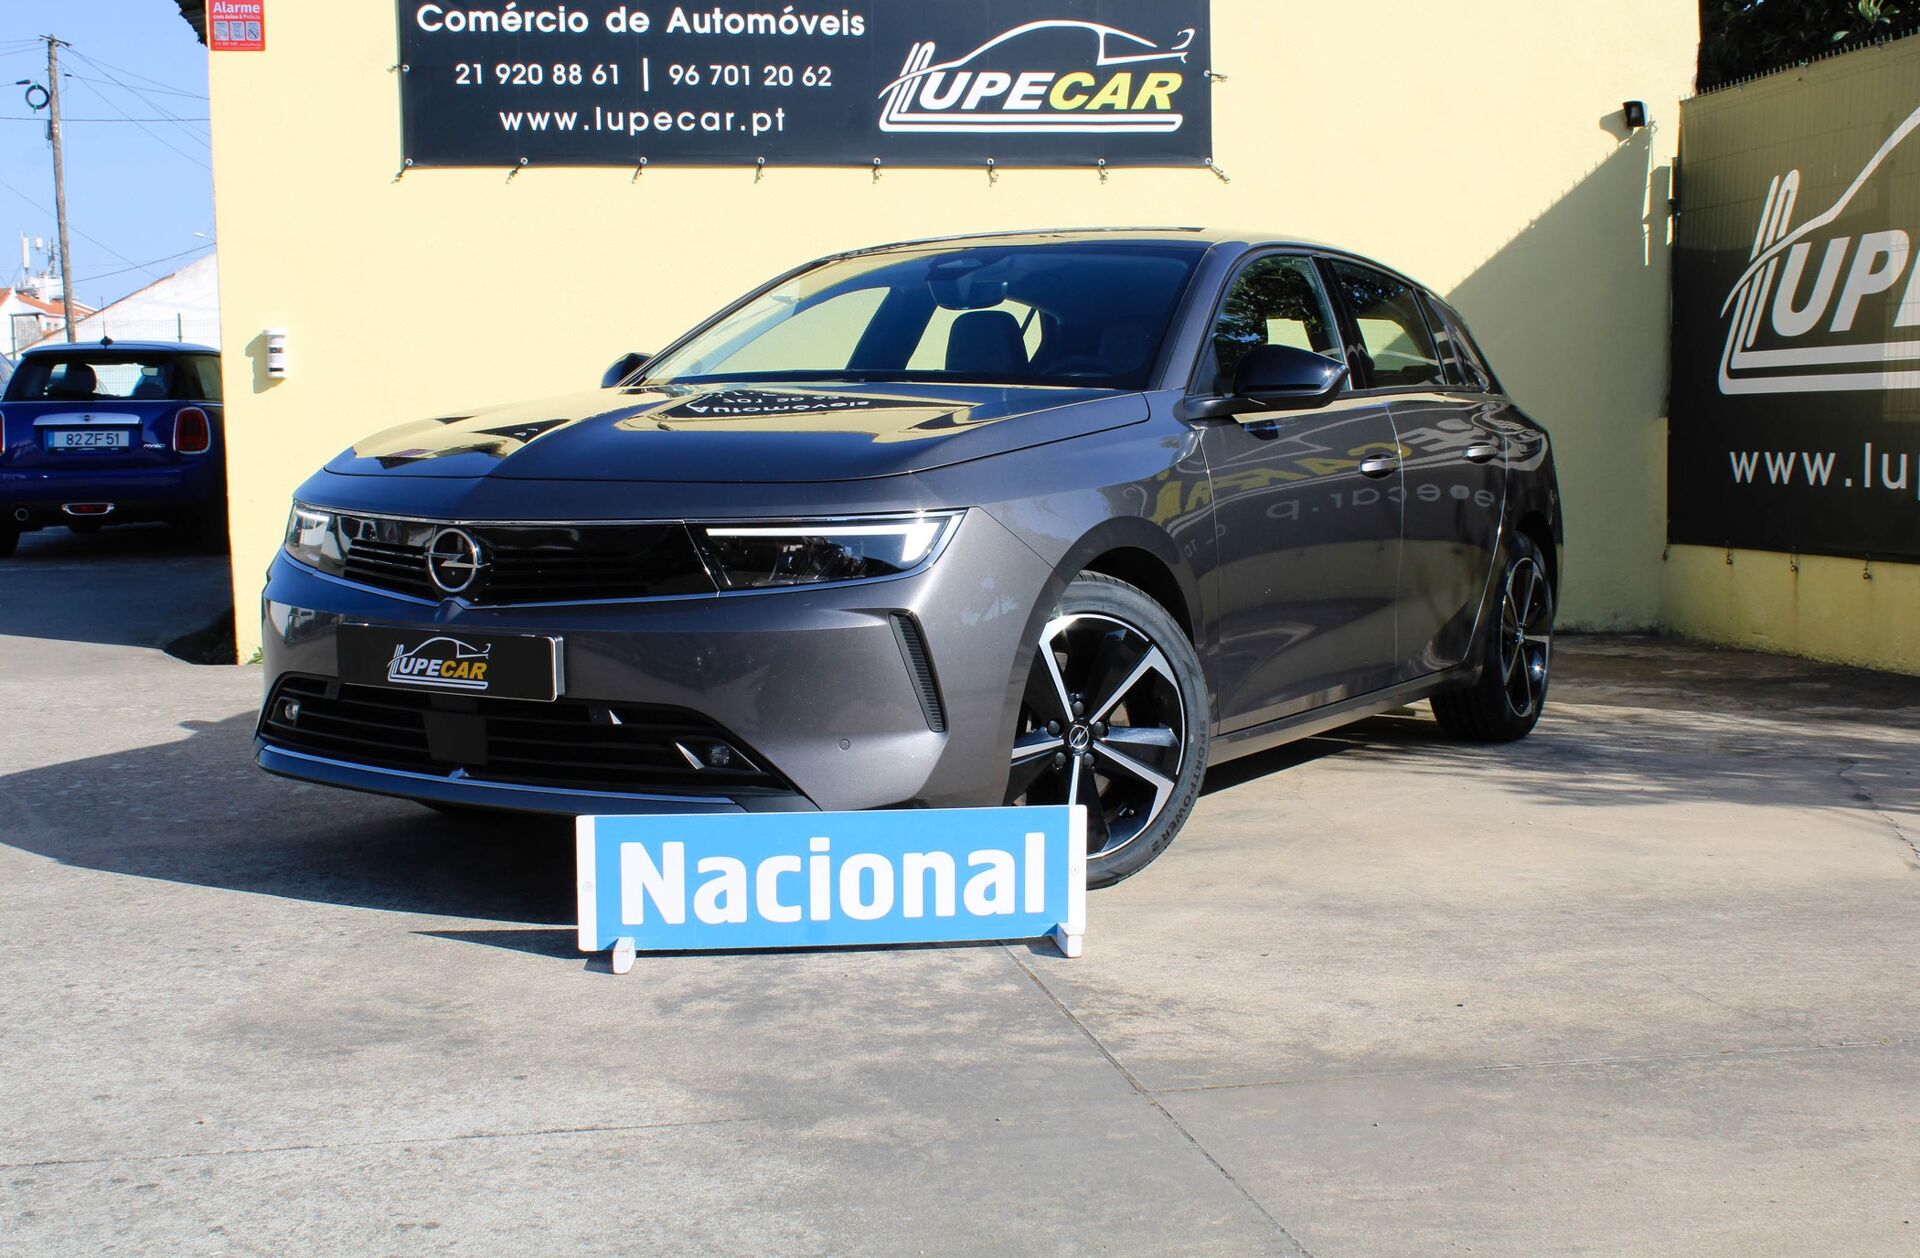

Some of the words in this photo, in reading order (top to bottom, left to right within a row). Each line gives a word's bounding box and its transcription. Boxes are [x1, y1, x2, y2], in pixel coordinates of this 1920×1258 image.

[213, 1, 260, 13] Alarme
[416, 2, 589, 33] Comércio
[605, 6, 650, 33] de
[666, 5, 865, 36] Automóveis
[455, 63, 482, 85] 21
[495, 63, 543, 85] 920
[552, 63, 583, 85] 88
[591, 64, 618, 85] 61
[668, 64, 700, 86] 96
[709, 64, 750, 86] 701
[763, 65, 794, 87] 20
[802, 65, 832, 87] 62
[499, 106, 785, 137] www.lupecar.pt
[66, 433, 82, 446] 82
[84, 433, 104, 446] ZF
[106, 433, 120, 446] 51
[1729, 442, 1920, 501] www.lu
[620, 832, 1045, 925] Nacional
